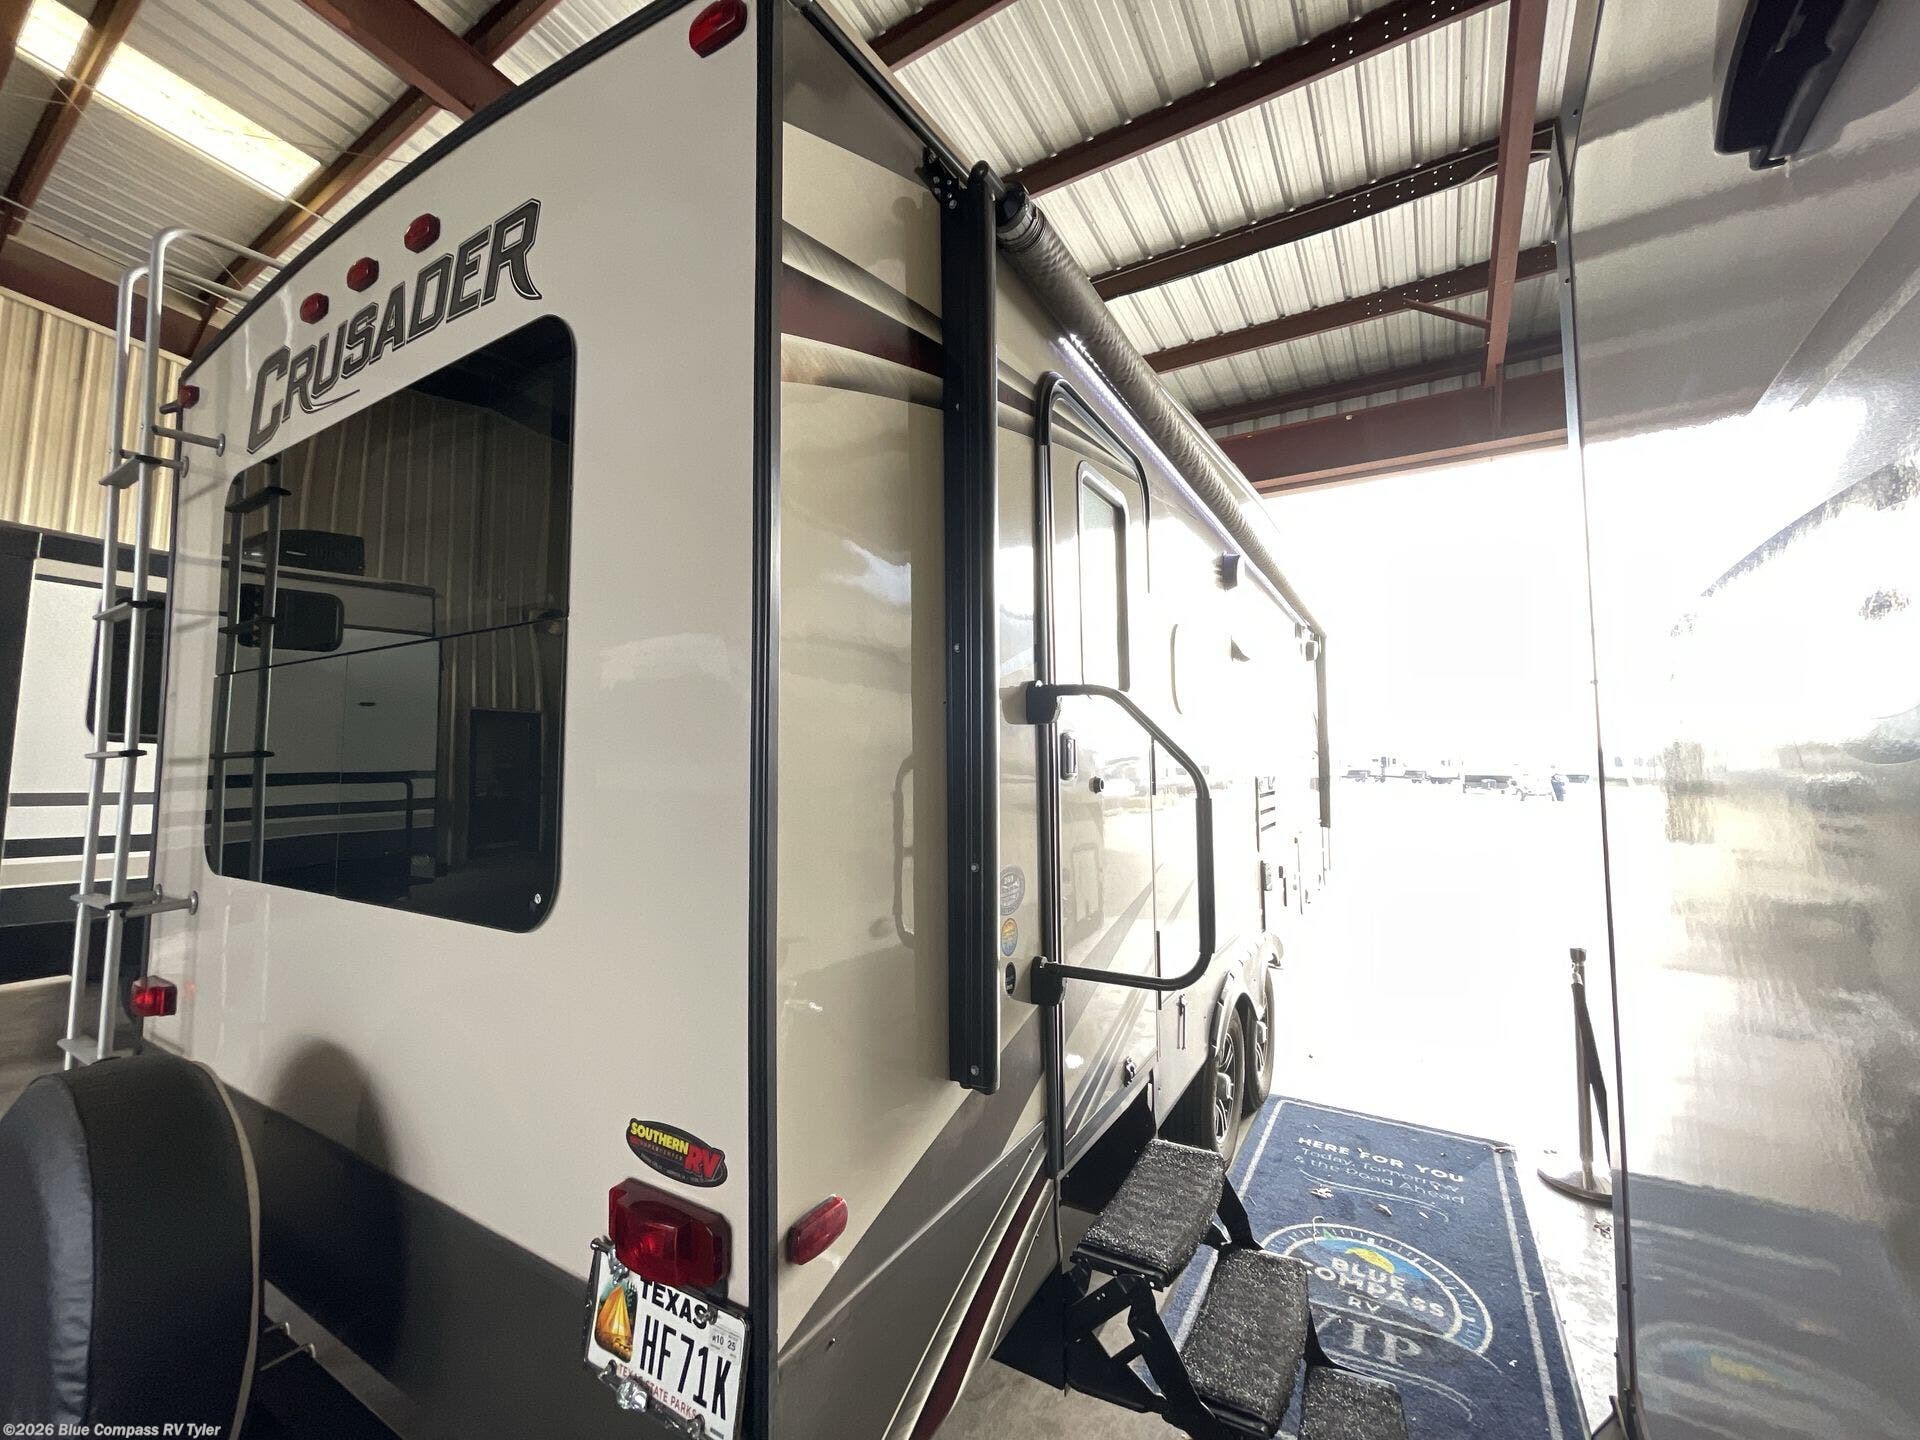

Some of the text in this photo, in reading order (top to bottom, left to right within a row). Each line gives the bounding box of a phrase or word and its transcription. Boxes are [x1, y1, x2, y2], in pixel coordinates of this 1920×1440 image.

[247, 198, 542, 453] CRUSADER
[630, 1121, 690, 1155] SOUTHERN
[684, 1143, 720, 1178] RV
[1298, 1137, 1464, 1182] HERE FOR YOU
[1311, 1159, 1340, 1173] the
[1399, 1183, 1465, 1205] Ahead
[1332, 1257, 1405, 1292] BLUE
[640, 1280, 709, 1329] TEXAS
[1348, 1296, 1380, 1312] RV
[639, 1315, 732, 1421] HF71K
[670, 1395, 697, 1419] PARKS
